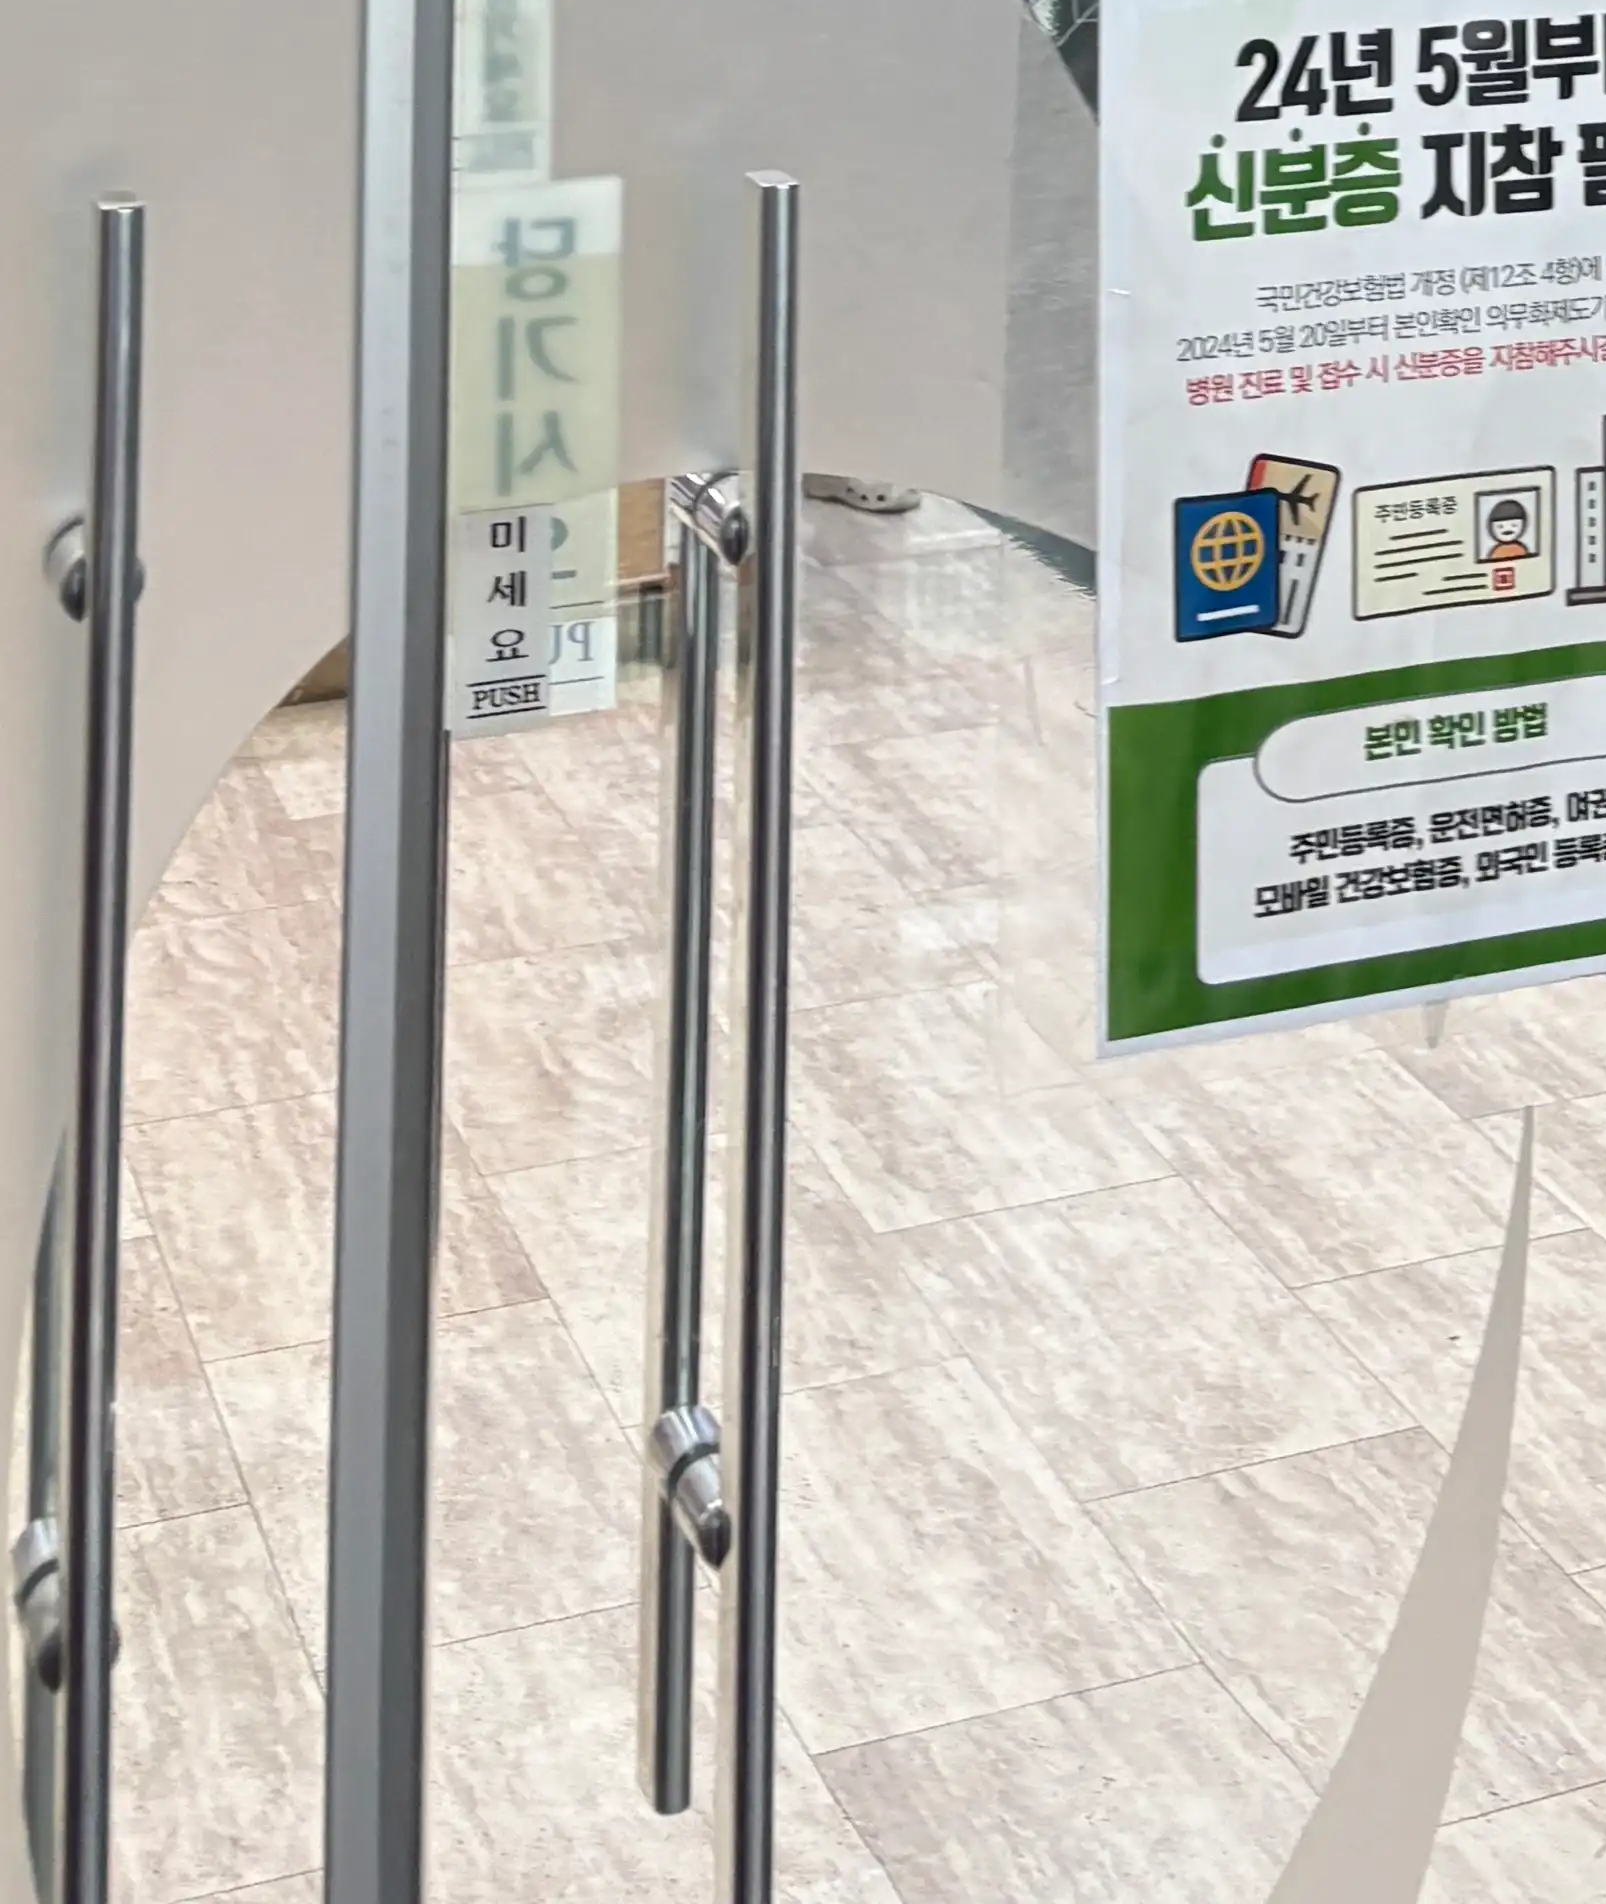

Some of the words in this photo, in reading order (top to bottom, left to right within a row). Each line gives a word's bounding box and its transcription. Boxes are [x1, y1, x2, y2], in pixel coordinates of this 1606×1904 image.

[1235, 27, 1396, 123] 24년
[1184, 122, 1402, 243] 신분증
[1419, 122, 1564, 221] 지참
[1255, 271, 1407, 313] 국민건강보험법
[1410, 267, 1456, 297] 개정
[1459, 261, 1538, 294] (제12조
[1176, 330, 1254, 362] 2024년
[1258, 324, 1297, 354] 5월
[1298, 313, 1389, 349] 20일부터
[1392, 305, 1482, 340] 본인확인
[1186, 373, 1235, 407] 병원
[1238, 368, 1286, 400] 진료
[1289, 363, 1314, 395] 및
[1317, 357, 1363, 391] 접수
[1365, 354, 1390, 384] 시
[1394, 345, 1487, 382] 신분증을
[1374, 495, 1459, 524] 주민등록증
[484, 514, 530, 665] 미세요
[470, 680, 542, 712] PUSH
[1363, 718, 1423, 762] 본인
[1427, 710, 1486, 751] 확인
[1492, 701, 1549, 744] 방법
[1287, 815, 1425, 865] 주민등록증,
[1430, 794, 1561, 846] 운전면허증,
[1253, 874, 1331, 919] 모바일
[1335, 854, 1471, 904] 건강보험증,
[1475, 841, 1550, 886] 외국인
